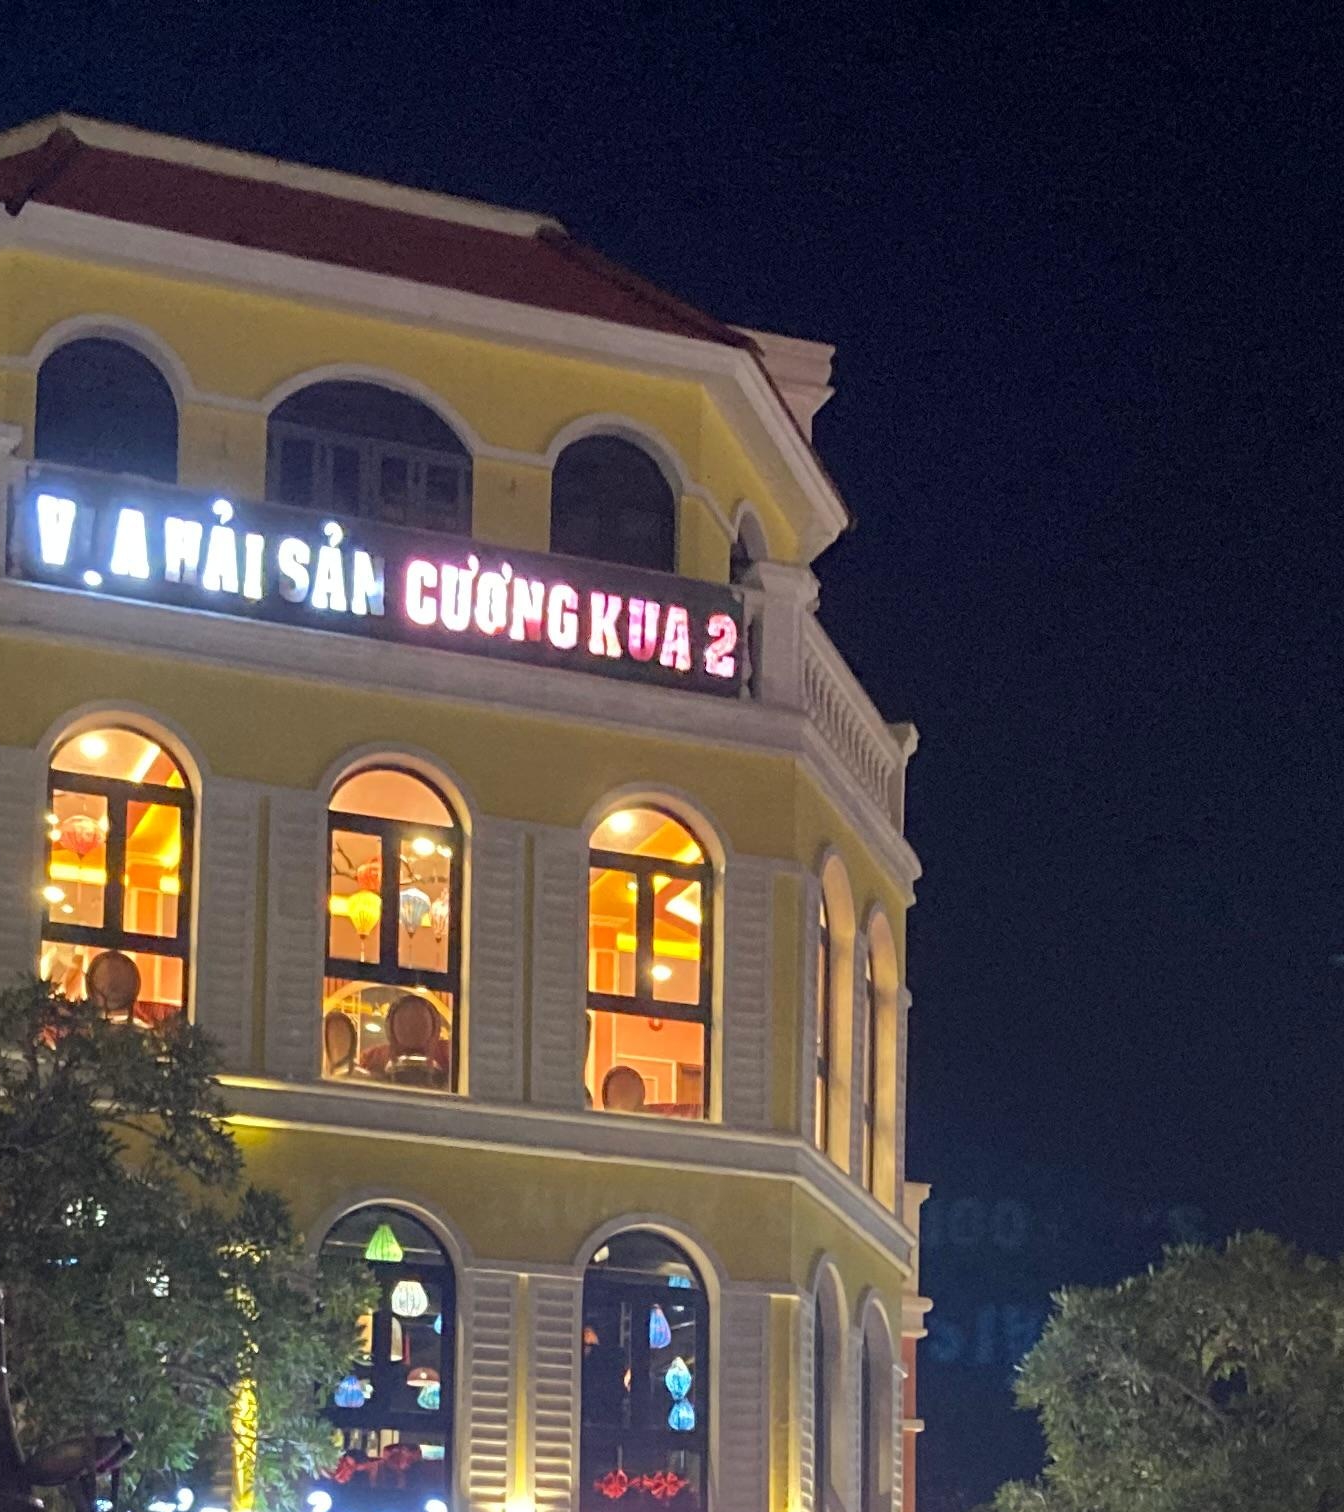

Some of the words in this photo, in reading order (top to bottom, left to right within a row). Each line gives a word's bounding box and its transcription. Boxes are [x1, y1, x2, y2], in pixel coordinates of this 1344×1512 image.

[37, 494, 150, 586] VA
[278, 521, 385, 616] SẢN
[588, 592, 692, 671] KUA
[705, 613, 738, 678] 2
